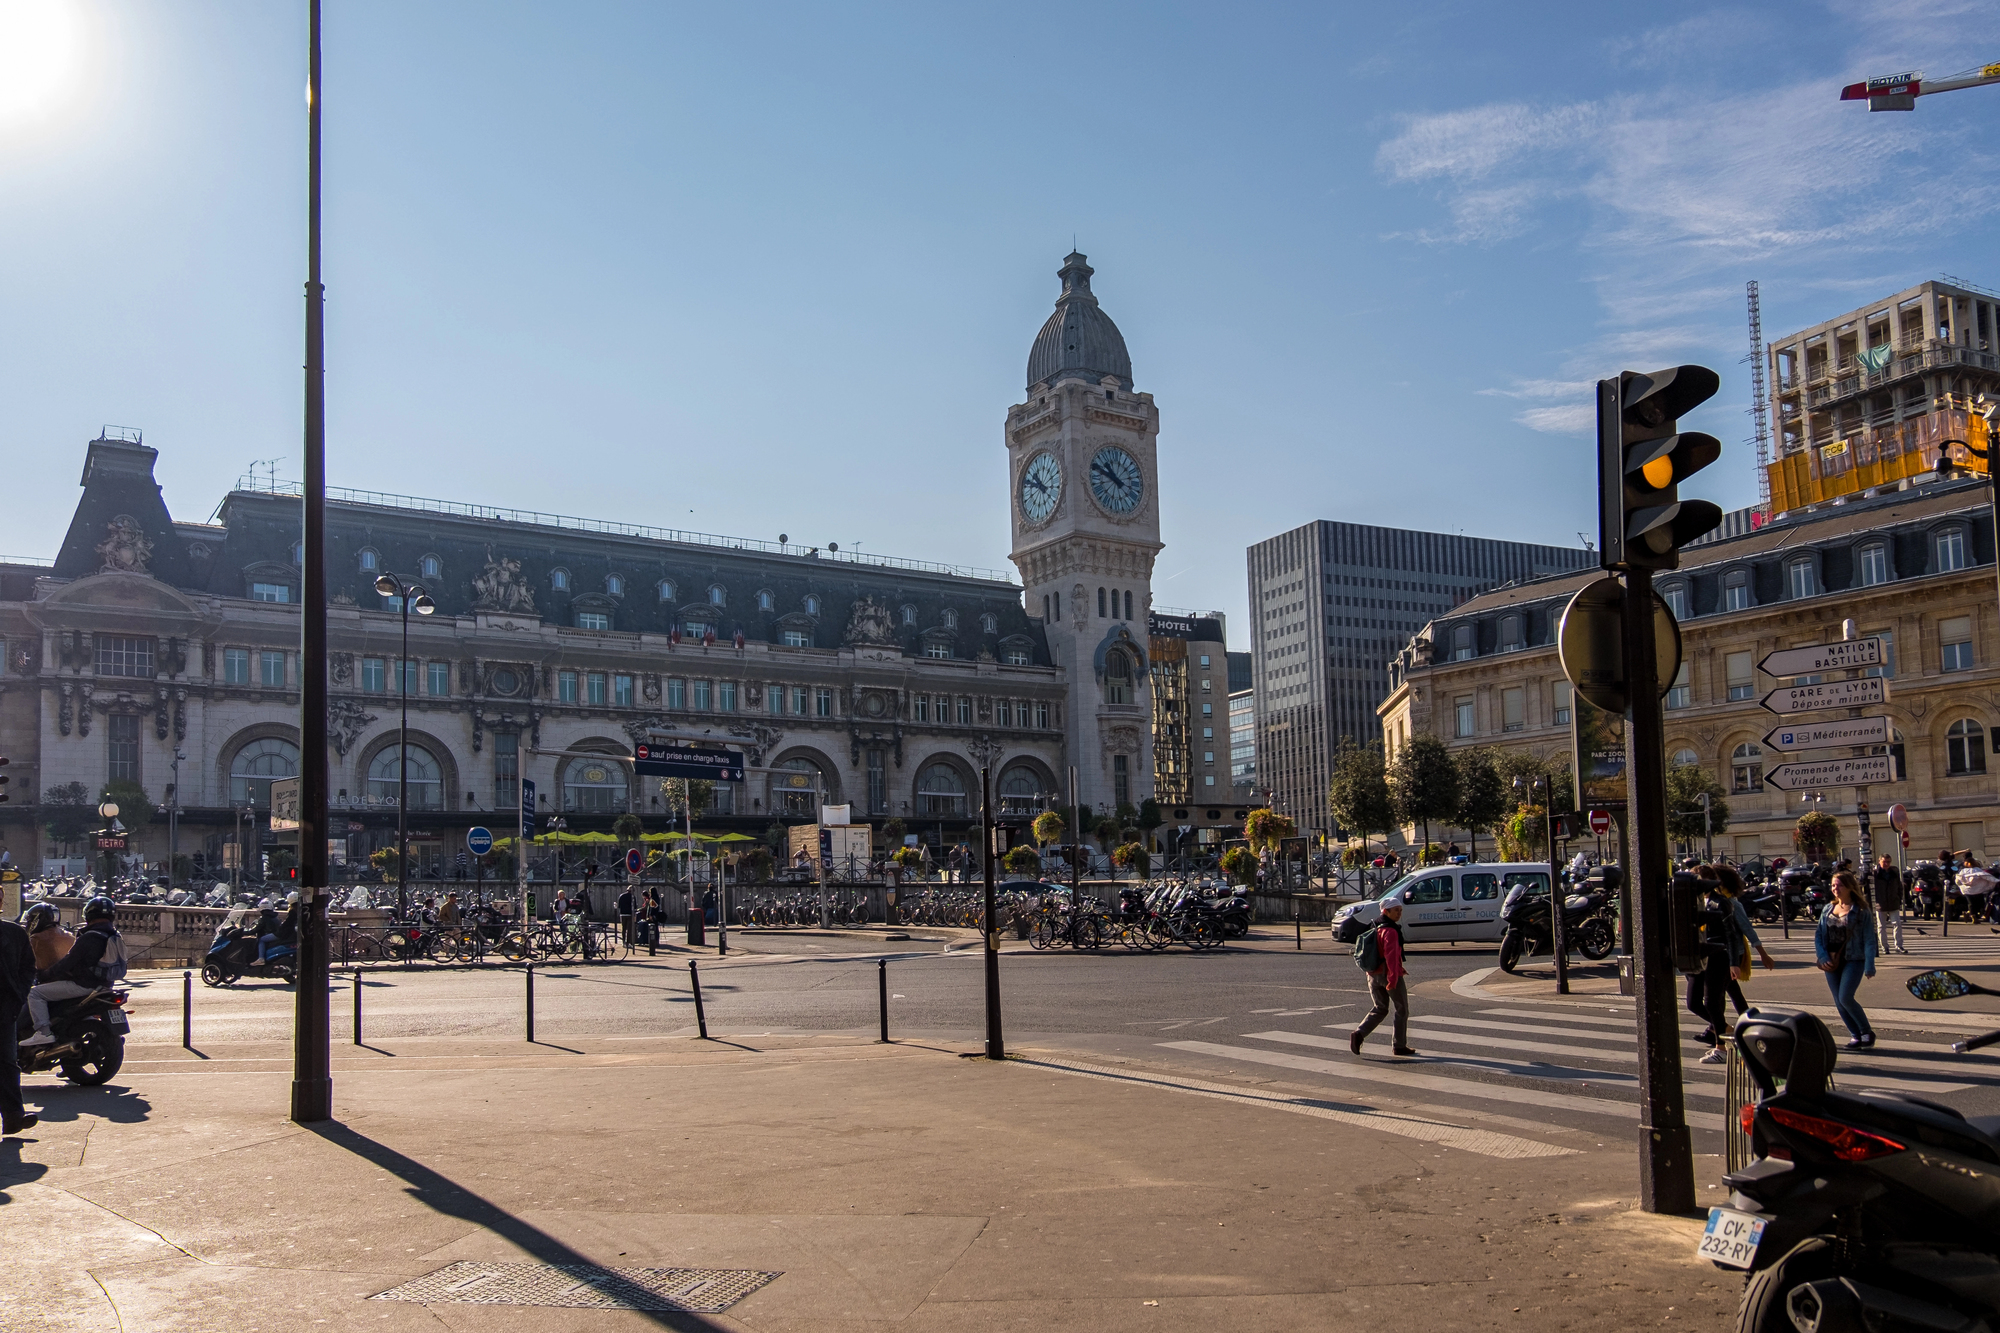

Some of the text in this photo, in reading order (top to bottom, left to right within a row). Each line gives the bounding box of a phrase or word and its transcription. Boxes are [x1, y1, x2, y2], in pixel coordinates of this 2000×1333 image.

[1872, 73, 1912, 86] POTAIN
[1828, 641, 1875, 656] NATION
[1815, 652, 1876, 668] BASTILLE
[1790, 681, 1878, 699] GARE DE LYON
[1791, 692, 1880, 710] Dépose minute
[1812, 726, 1883, 741] Méditerranée
[651, 750, 666, 759] sauf
[666, 752, 682, 761] prise
[693, 754, 714, 764] charge
[714, 755, 730, 764] Taxis
[1783, 761, 1885, 776] Promenade Plantée
[1790, 771, 1886, 786] Viaduc des Arts
[351, 795, 367, 804] DE
[1419, 912, 1458, 920] PREFECTURE
[1476, 910, 1500, 918] POLICE
[1750, 1231, 1760, 1242] 75
[1701, 1235, 1754, 1262] 232-RY
